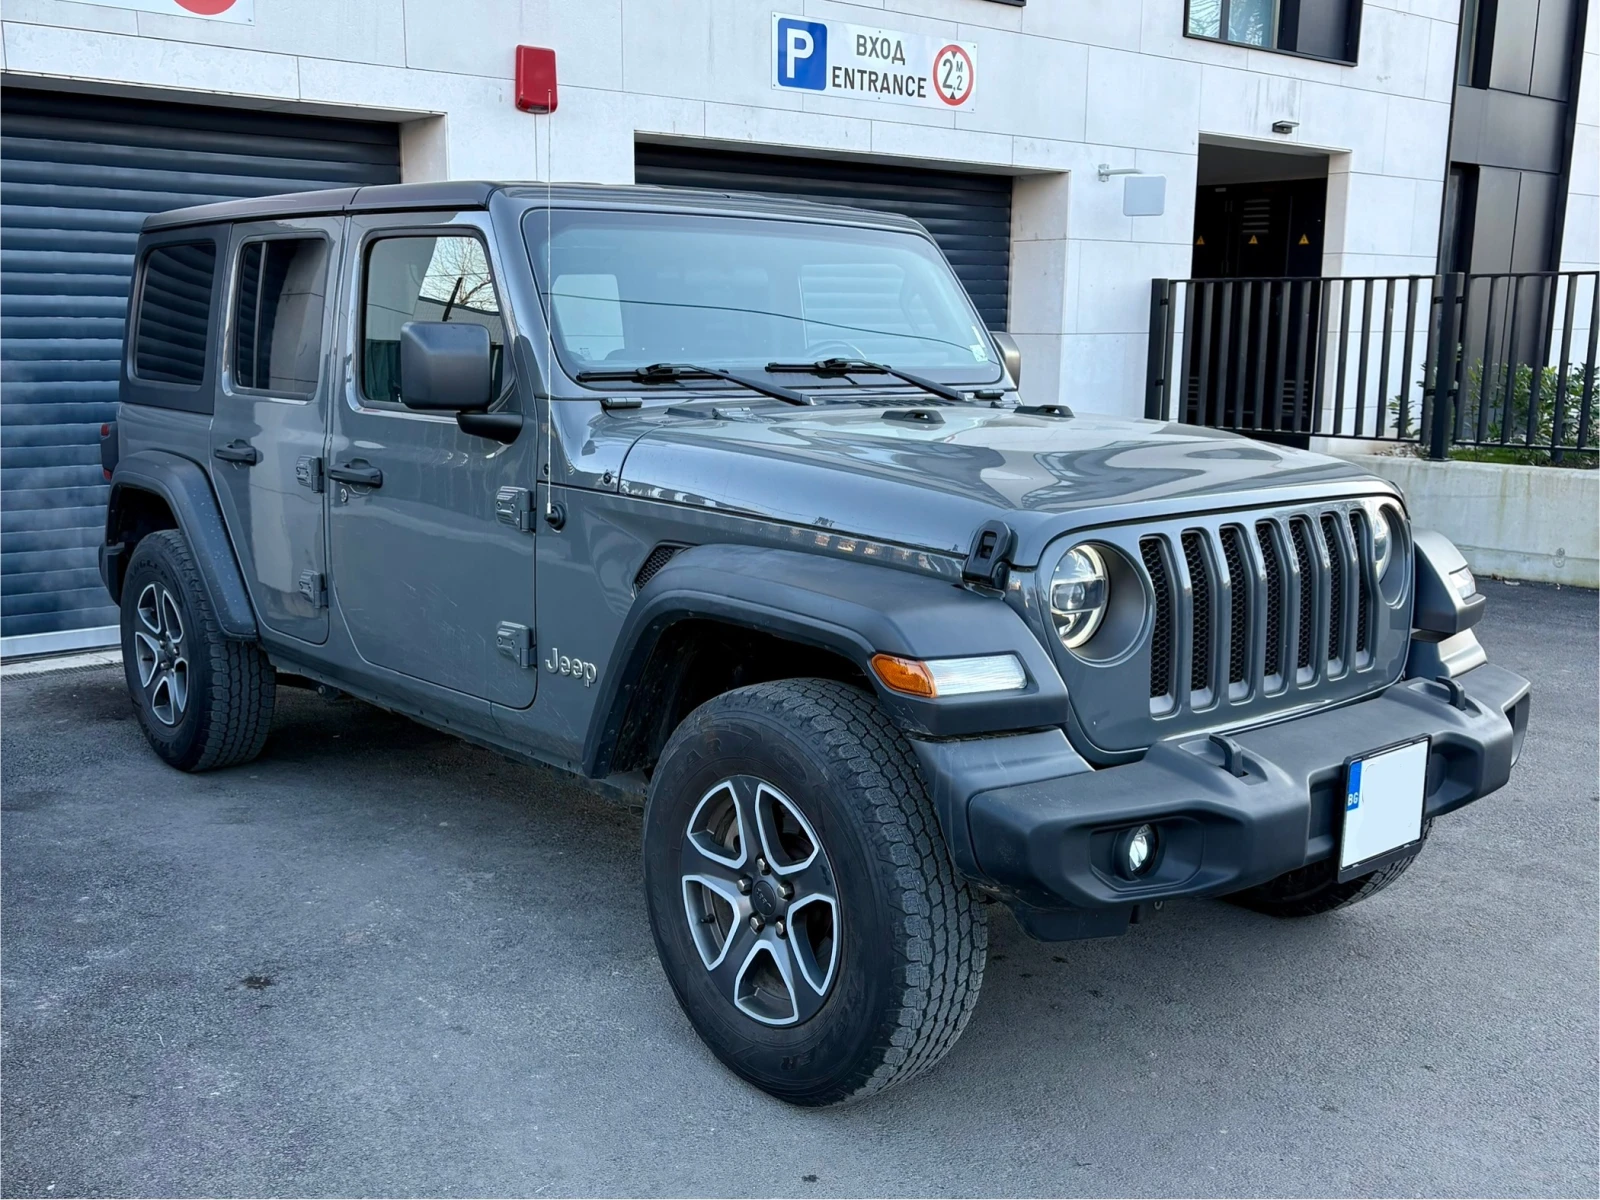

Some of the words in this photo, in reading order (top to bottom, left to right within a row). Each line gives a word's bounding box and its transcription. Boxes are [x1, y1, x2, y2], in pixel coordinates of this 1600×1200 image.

[786, 28, 814, 79] P
[856, 34, 905, 66] ВХОД
[832, 66, 927, 98] ENTRANCE
[545, 647, 597, 688] Jeep
[1348, 792, 1358, 806] BG
